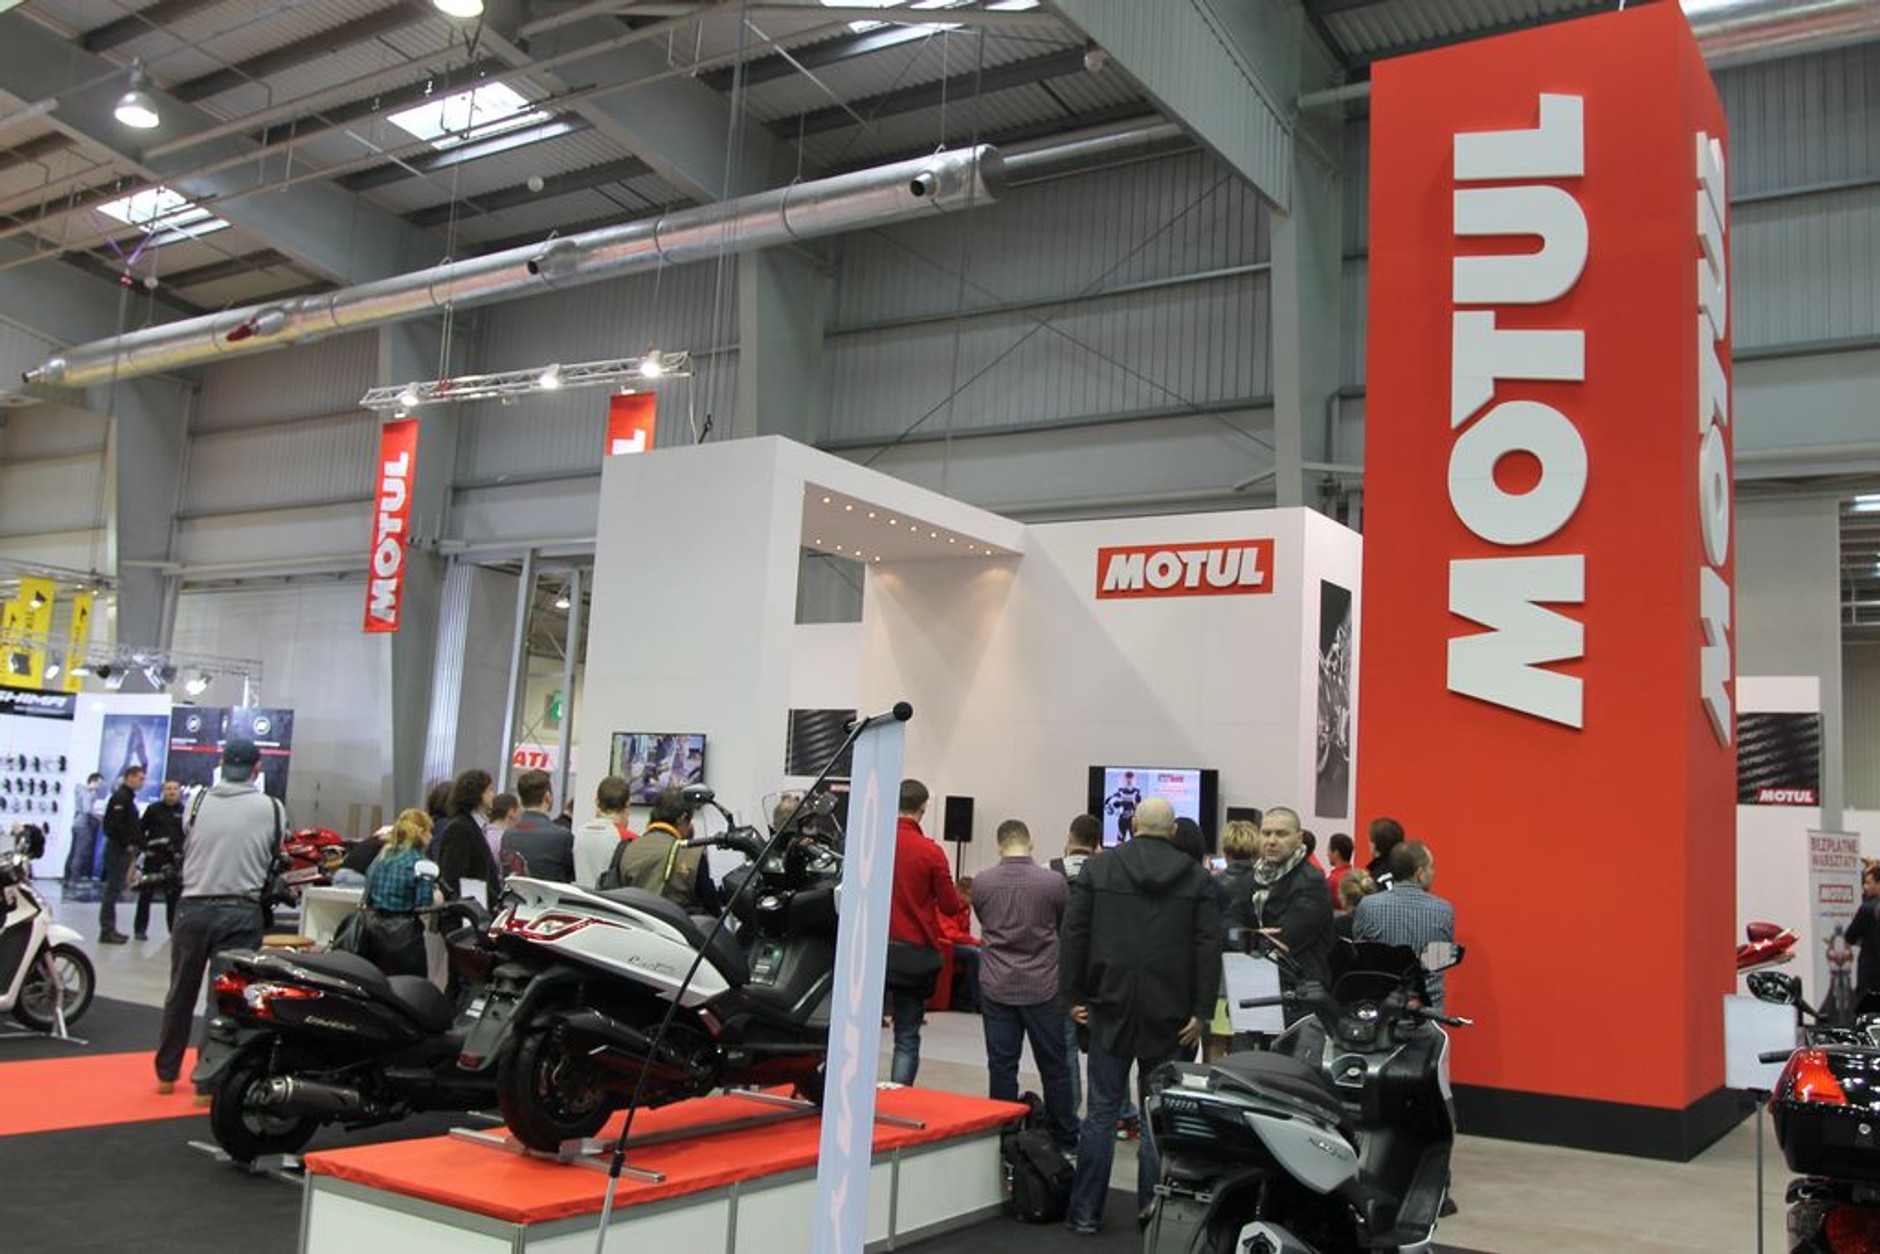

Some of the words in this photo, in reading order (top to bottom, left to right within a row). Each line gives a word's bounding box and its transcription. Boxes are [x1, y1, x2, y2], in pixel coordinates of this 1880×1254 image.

[1447, 92, 1590, 730] MOTUL
[1696, 131, 1734, 748] MOTUL
[369, 451, 409, 623] MOTUL
[1102, 546, 1265, 591] MOTUL
[1759, 789, 1814, 803] MOTUL
